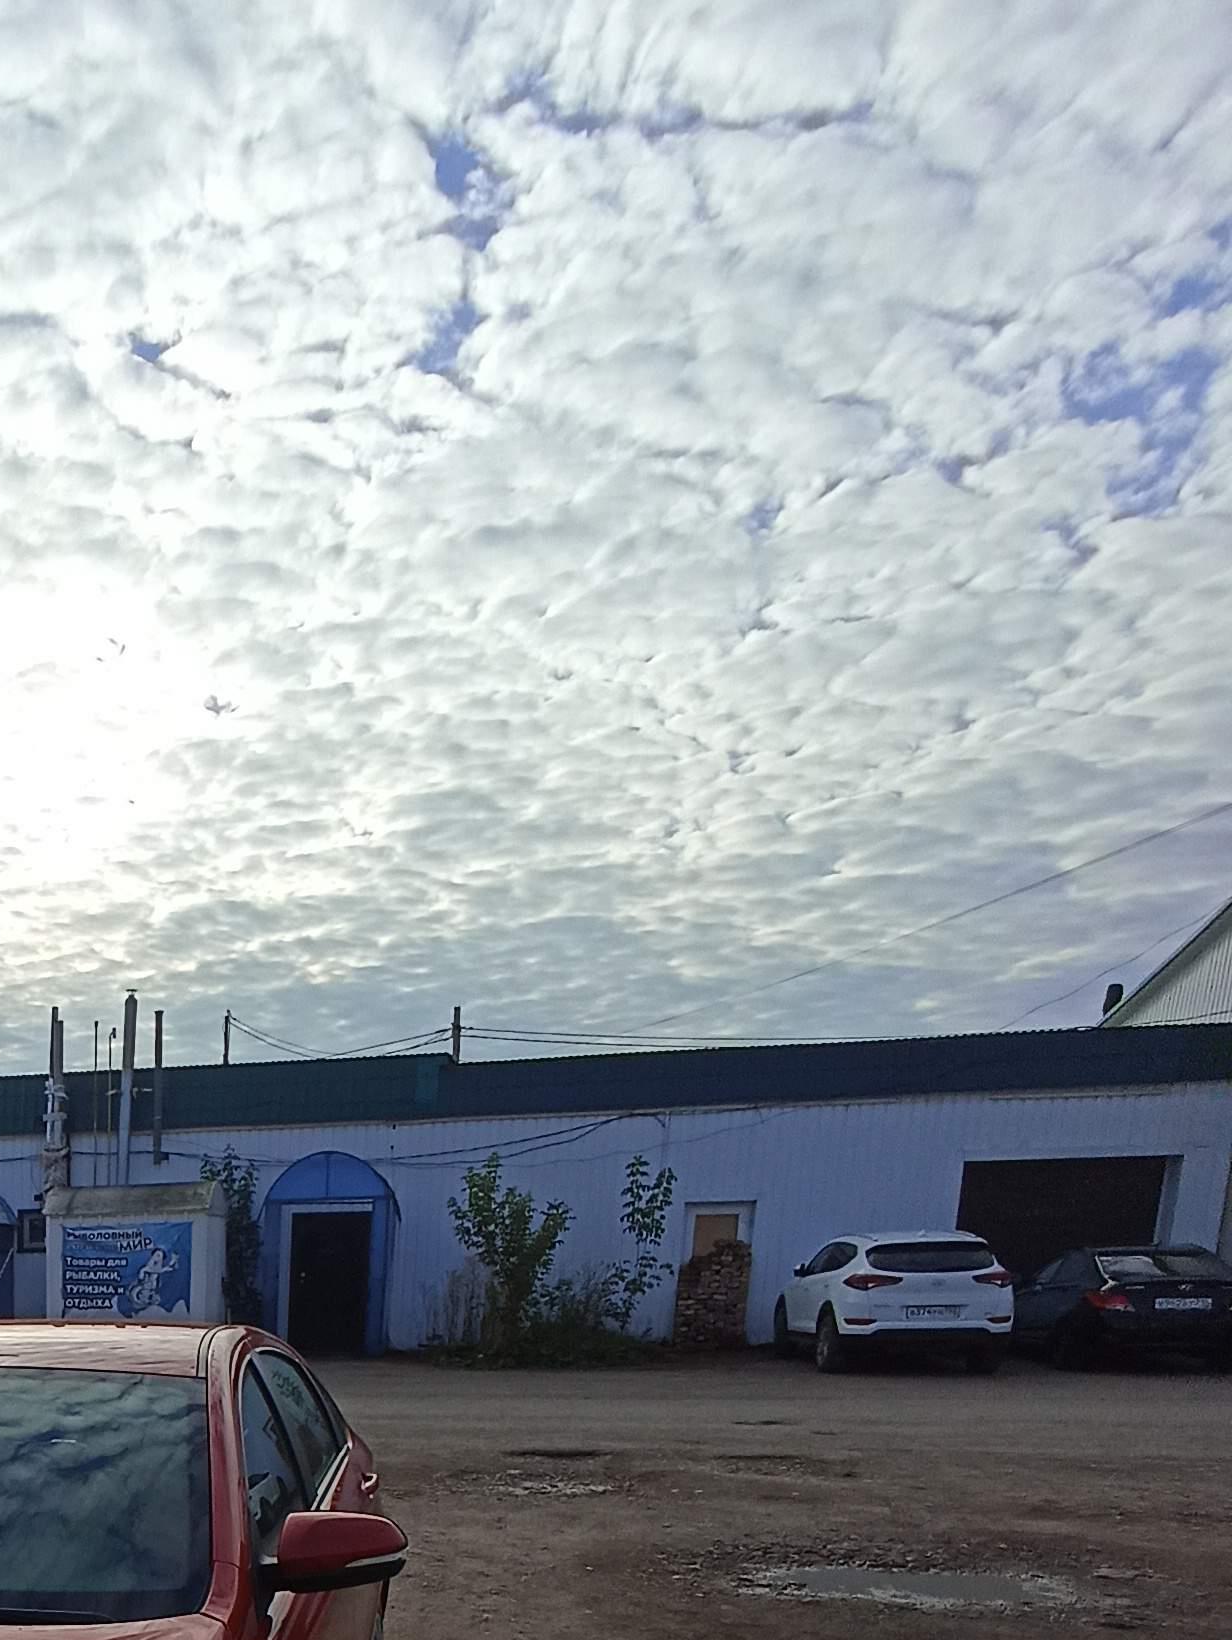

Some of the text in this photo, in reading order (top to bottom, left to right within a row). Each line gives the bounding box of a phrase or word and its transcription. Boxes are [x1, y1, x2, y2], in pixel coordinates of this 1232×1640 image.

[119, 1237, 153, 1253] МИР
[66, 1257, 127, 1268] Товары для
[66, 1284, 115, 1294] ТУРИЗМА
[65, 1298, 111, 1309] ОТДЫХА
